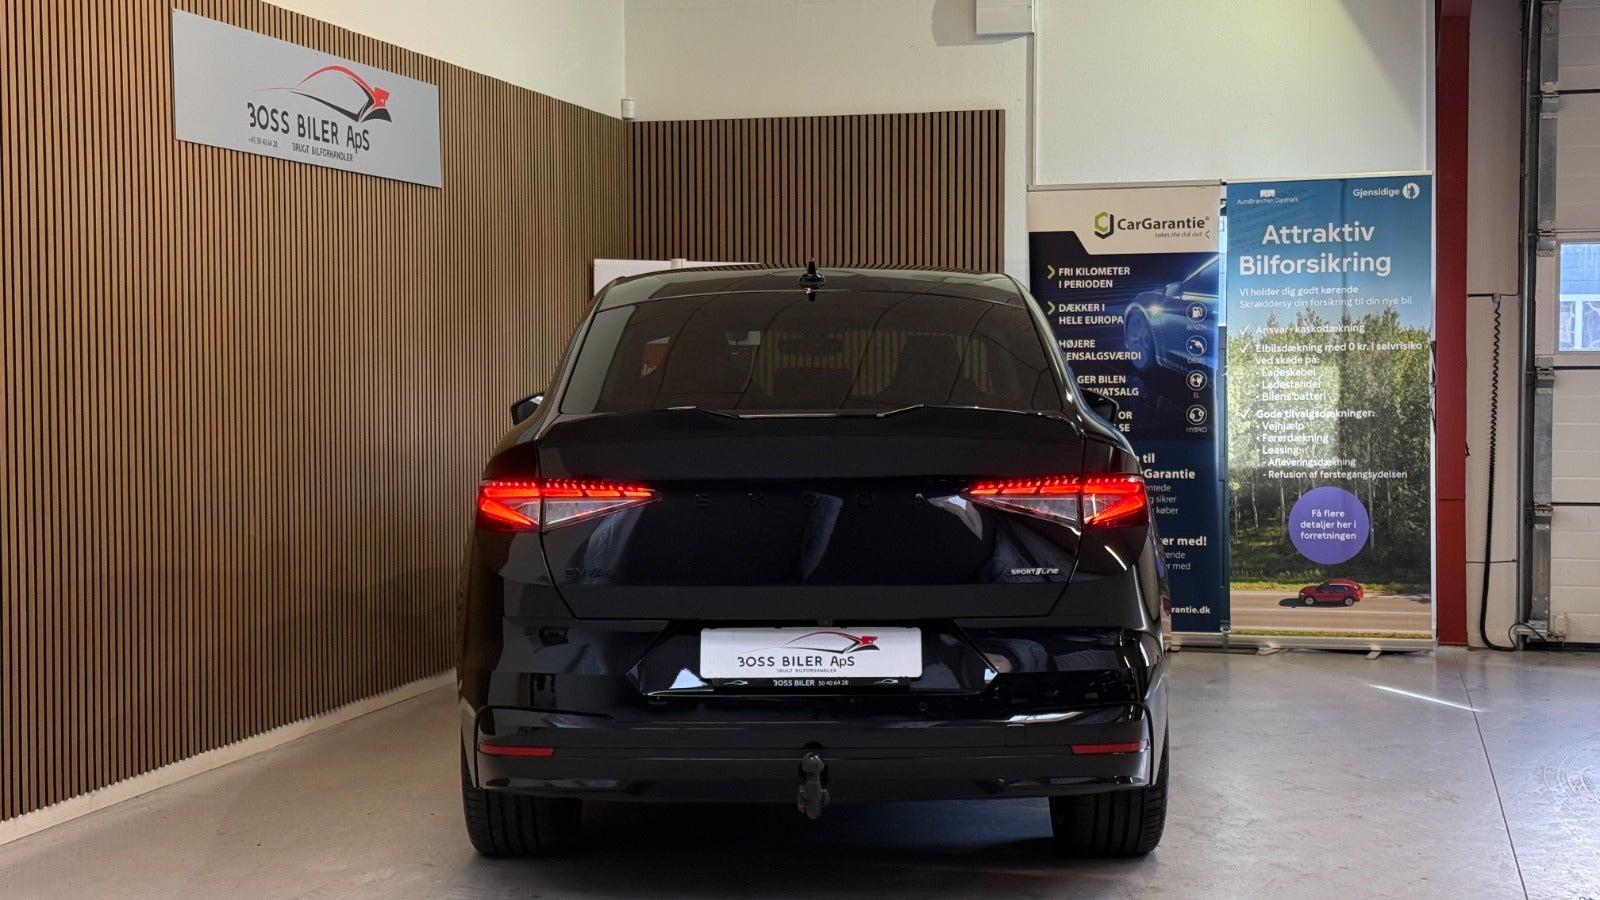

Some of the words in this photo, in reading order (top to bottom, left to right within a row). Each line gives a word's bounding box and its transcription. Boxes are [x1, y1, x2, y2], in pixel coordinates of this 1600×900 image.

[297, 114, 339, 145] BILER
[346, 125, 370, 154] ApS
[311, 146, 354, 161] BILFORHANDLER
[1353, 188, 1400, 197] Gjensidige
[1262, 221, 1375, 245] Attraktiv
[1239, 251, 1391, 277] Bilforsikring
[1059, 268, 1073, 277] FRI
[1075, 267, 1130, 276] KILOMETER
[1064, 279, 1113, 289] PERIODEN
[1239, 288, 1249, 296] Vi
[1250, 287, 1280, 296] holder
[1281, 287, 1296, 297] dig
[1297, 286, 1319, 297] godt
[1321, 285, 1358, 294] kørende
[1239, 300, 1292, 310] Skræddersy
[1294, 299, 1308, 307] din
[1310, 298, 1353, 308] forsikring
[1355, 297, 1364, 305] til
[1366, 297, 1380, 305] din
[1382, 297, 1399, 306] nye
[1401, 296, 1413, 304] bil
[1059, 304, 1099, 313] DÆKKER
[1059, 316, 1084, 325] HELE
[1085, 316, 1124, 325] EUROPA
[1294, 324, 1366, 334] kaskodækning
[1059, 340, 1096, 348] HØJERE
[1255, 343, 1323, 353] Elbilsdækning
[1325, 343, 1346, 352] med
[1348, 342, 1355, 351] 0
[1357, 342, 1369, 350] kr.
[1376, 341, 1423, 351] selvrisiko
[1065, 352, 1141, 361] ENSALGSVÆRDI
[1256, 356, 1273, 365] ved
[1275, 355, 1303, 364] skade
[1262, 368, 1316, 377] Ladeskabel
[1077, 375, 1097, 384] GER
[1098, 375, 1126, 384] BILEN
[1262, 381, 1322, 389] Ladestander
[1262, 392, 1291, 401] Bilens
[1293, 392, 1326, 401] batteri
[1256, 409, 1282, 418] Gode
[1284, 408, 1376, 420] tilvalgsdækninger:
[1262, 421, 1304, 432] Vejhjælp
[1262, 433, 1329, 444] Førerdækning
[1143, 453, 1155, 463] til
[1268, 457, 1356, 467] Afleveringsdækning
[1141, 469, 1196, 480] Garantie
[1268, 470, 1306, 479] Refusion
[1309, 470, 1318, 479] af
[1320, 470, 1408, 480] førstegangsydelsen
[1156, 495, 1177, 503] sikrer
[1156, 505, 1179, 515] køber
[1311, 508, 1322, 518] Få
[1323, 508, 1345, 518] flere
[1300, 520, 1335, 530] detaljer
[1336, 520, 1352, 529] her
[1177, 536, 1207, 546] med!
[1300, 531, 1357, 541] forretningen
[1172, 561, 1191, 570] med
[1171, 605, 1211, 615] rantie.dk
[782, 656, 823, 667] BILER
[830, 656, 855, 669] ApS
[794, 679, 815, 687] BILER
